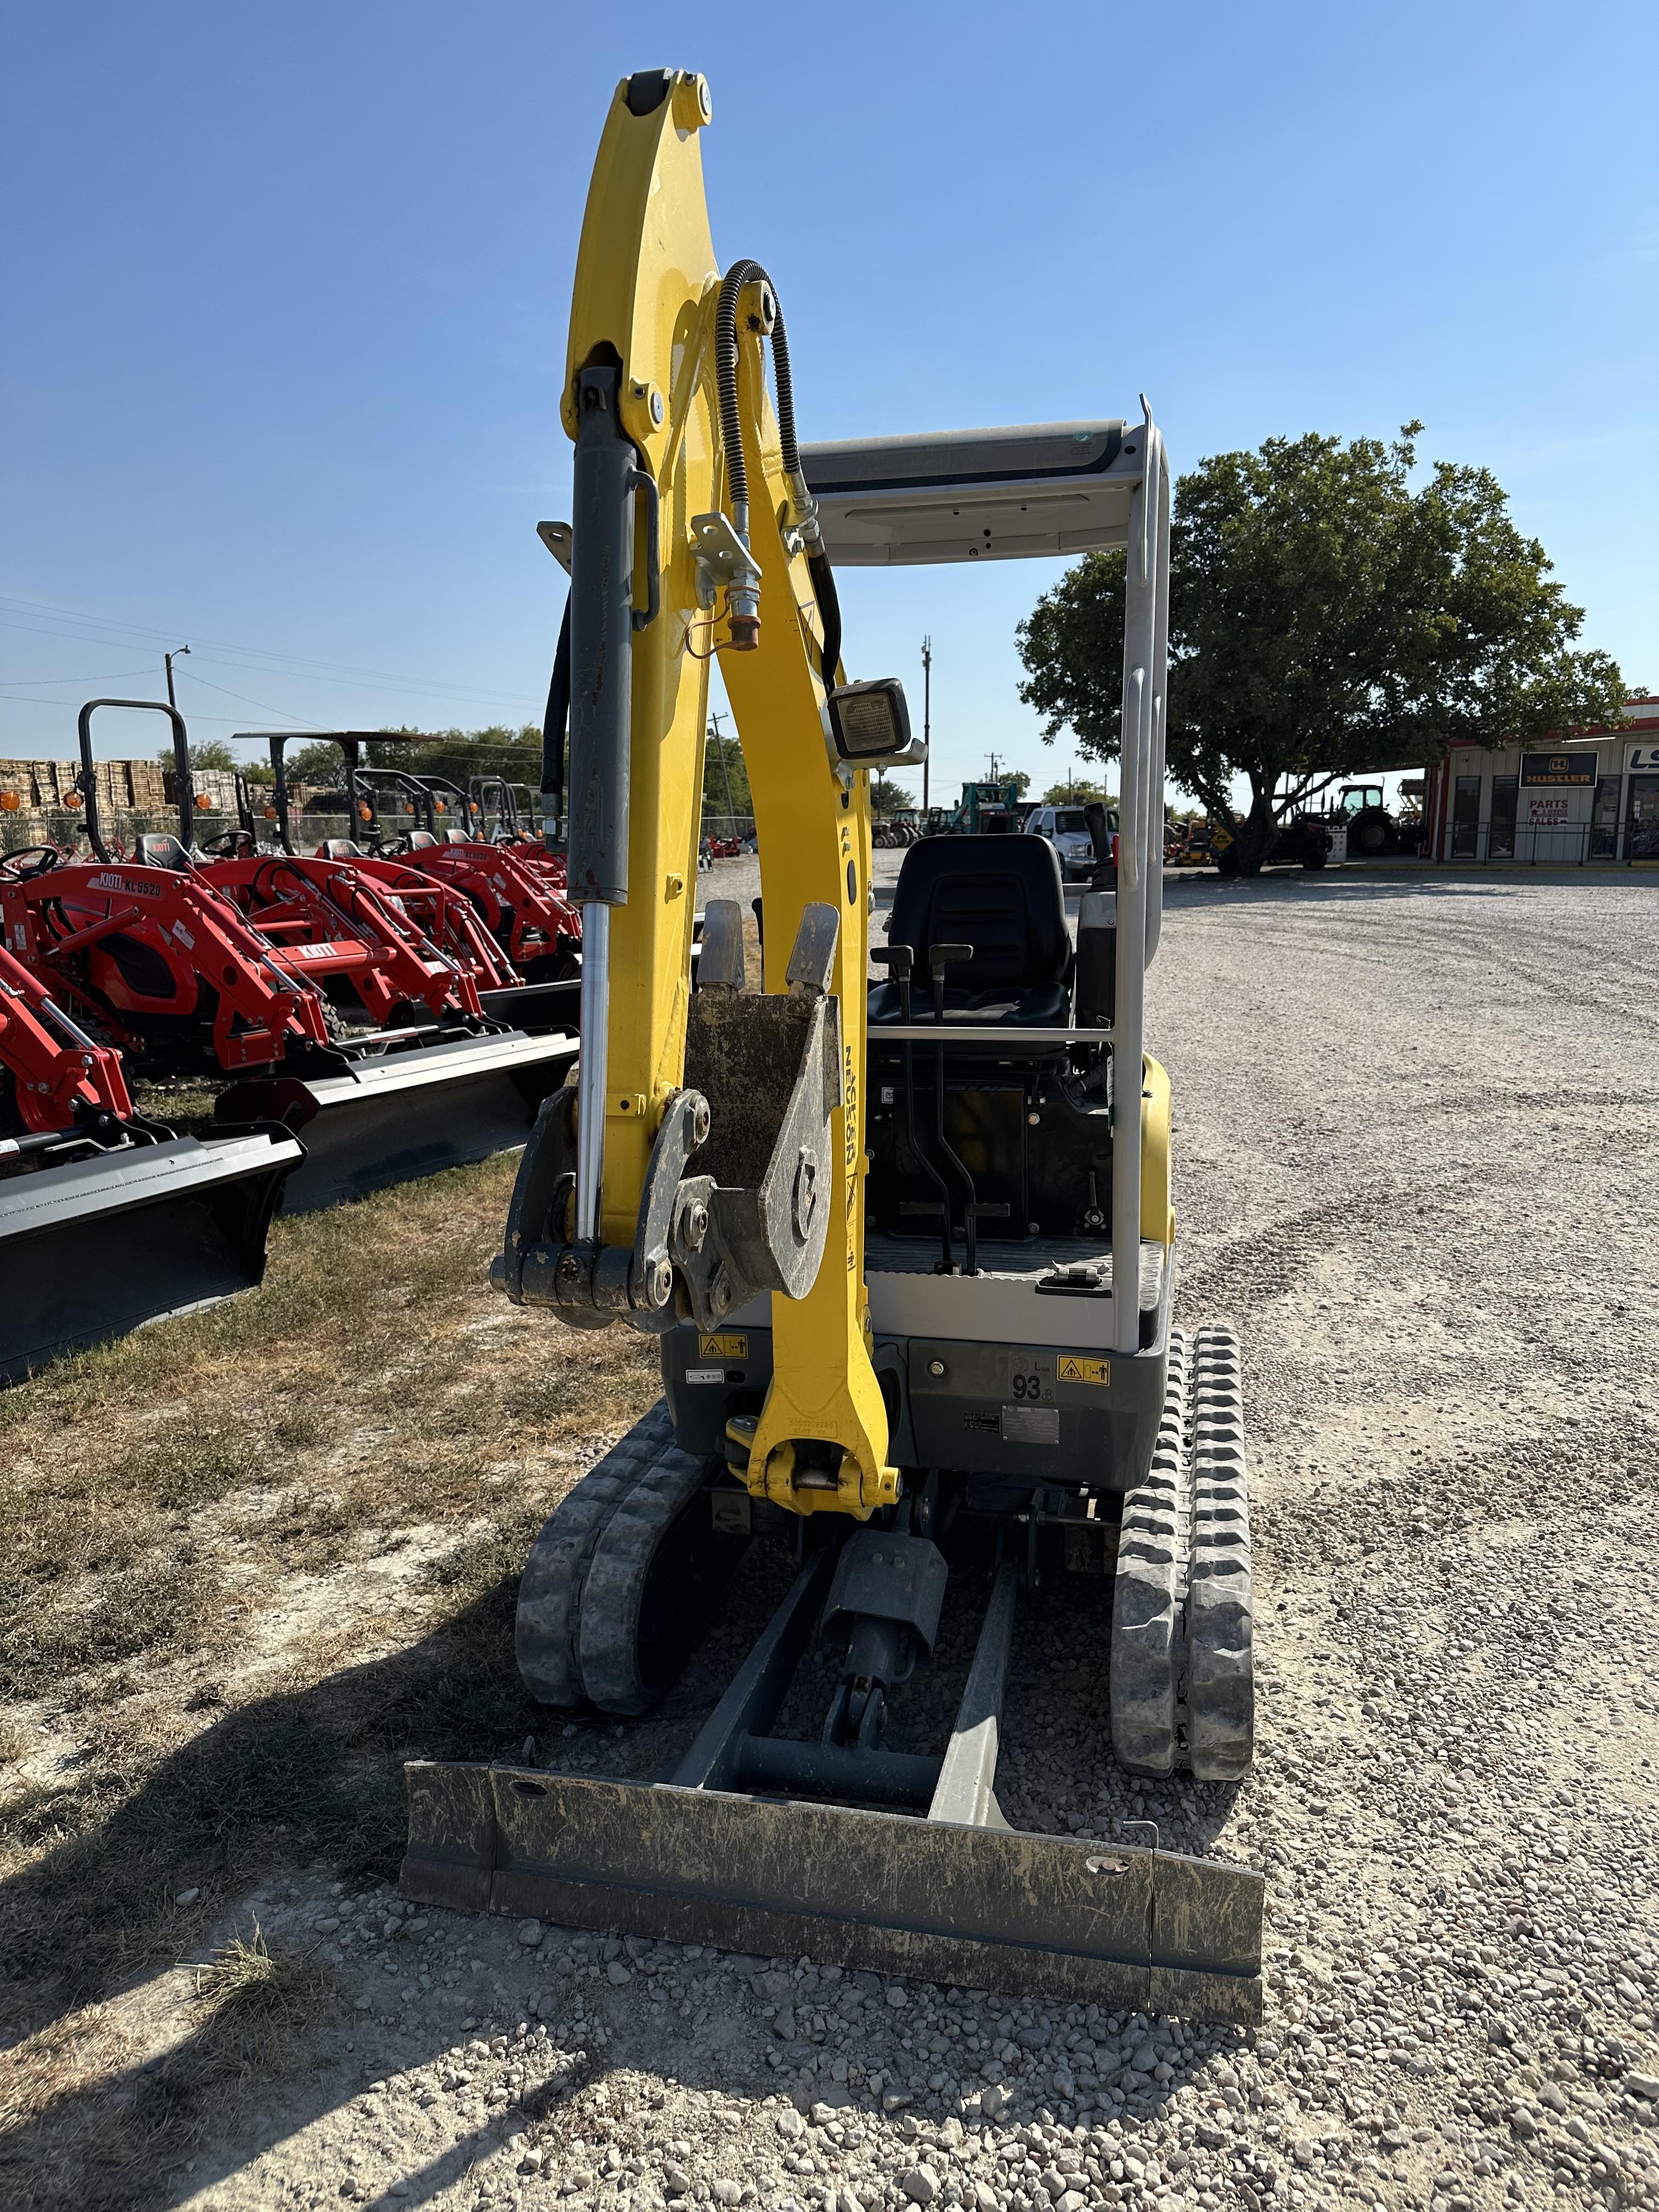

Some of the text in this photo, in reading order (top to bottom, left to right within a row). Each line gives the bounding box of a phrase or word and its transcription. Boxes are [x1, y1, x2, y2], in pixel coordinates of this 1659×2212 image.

[1530, 799, 1568, 808] PARTS
[153, 842, 170, 852] KIOTI
[99, 872, 122, 890] KIOTI
[298, 943, 338, 959] KIOTI
[1013, 1374, 1052, 1401] 93 dB
